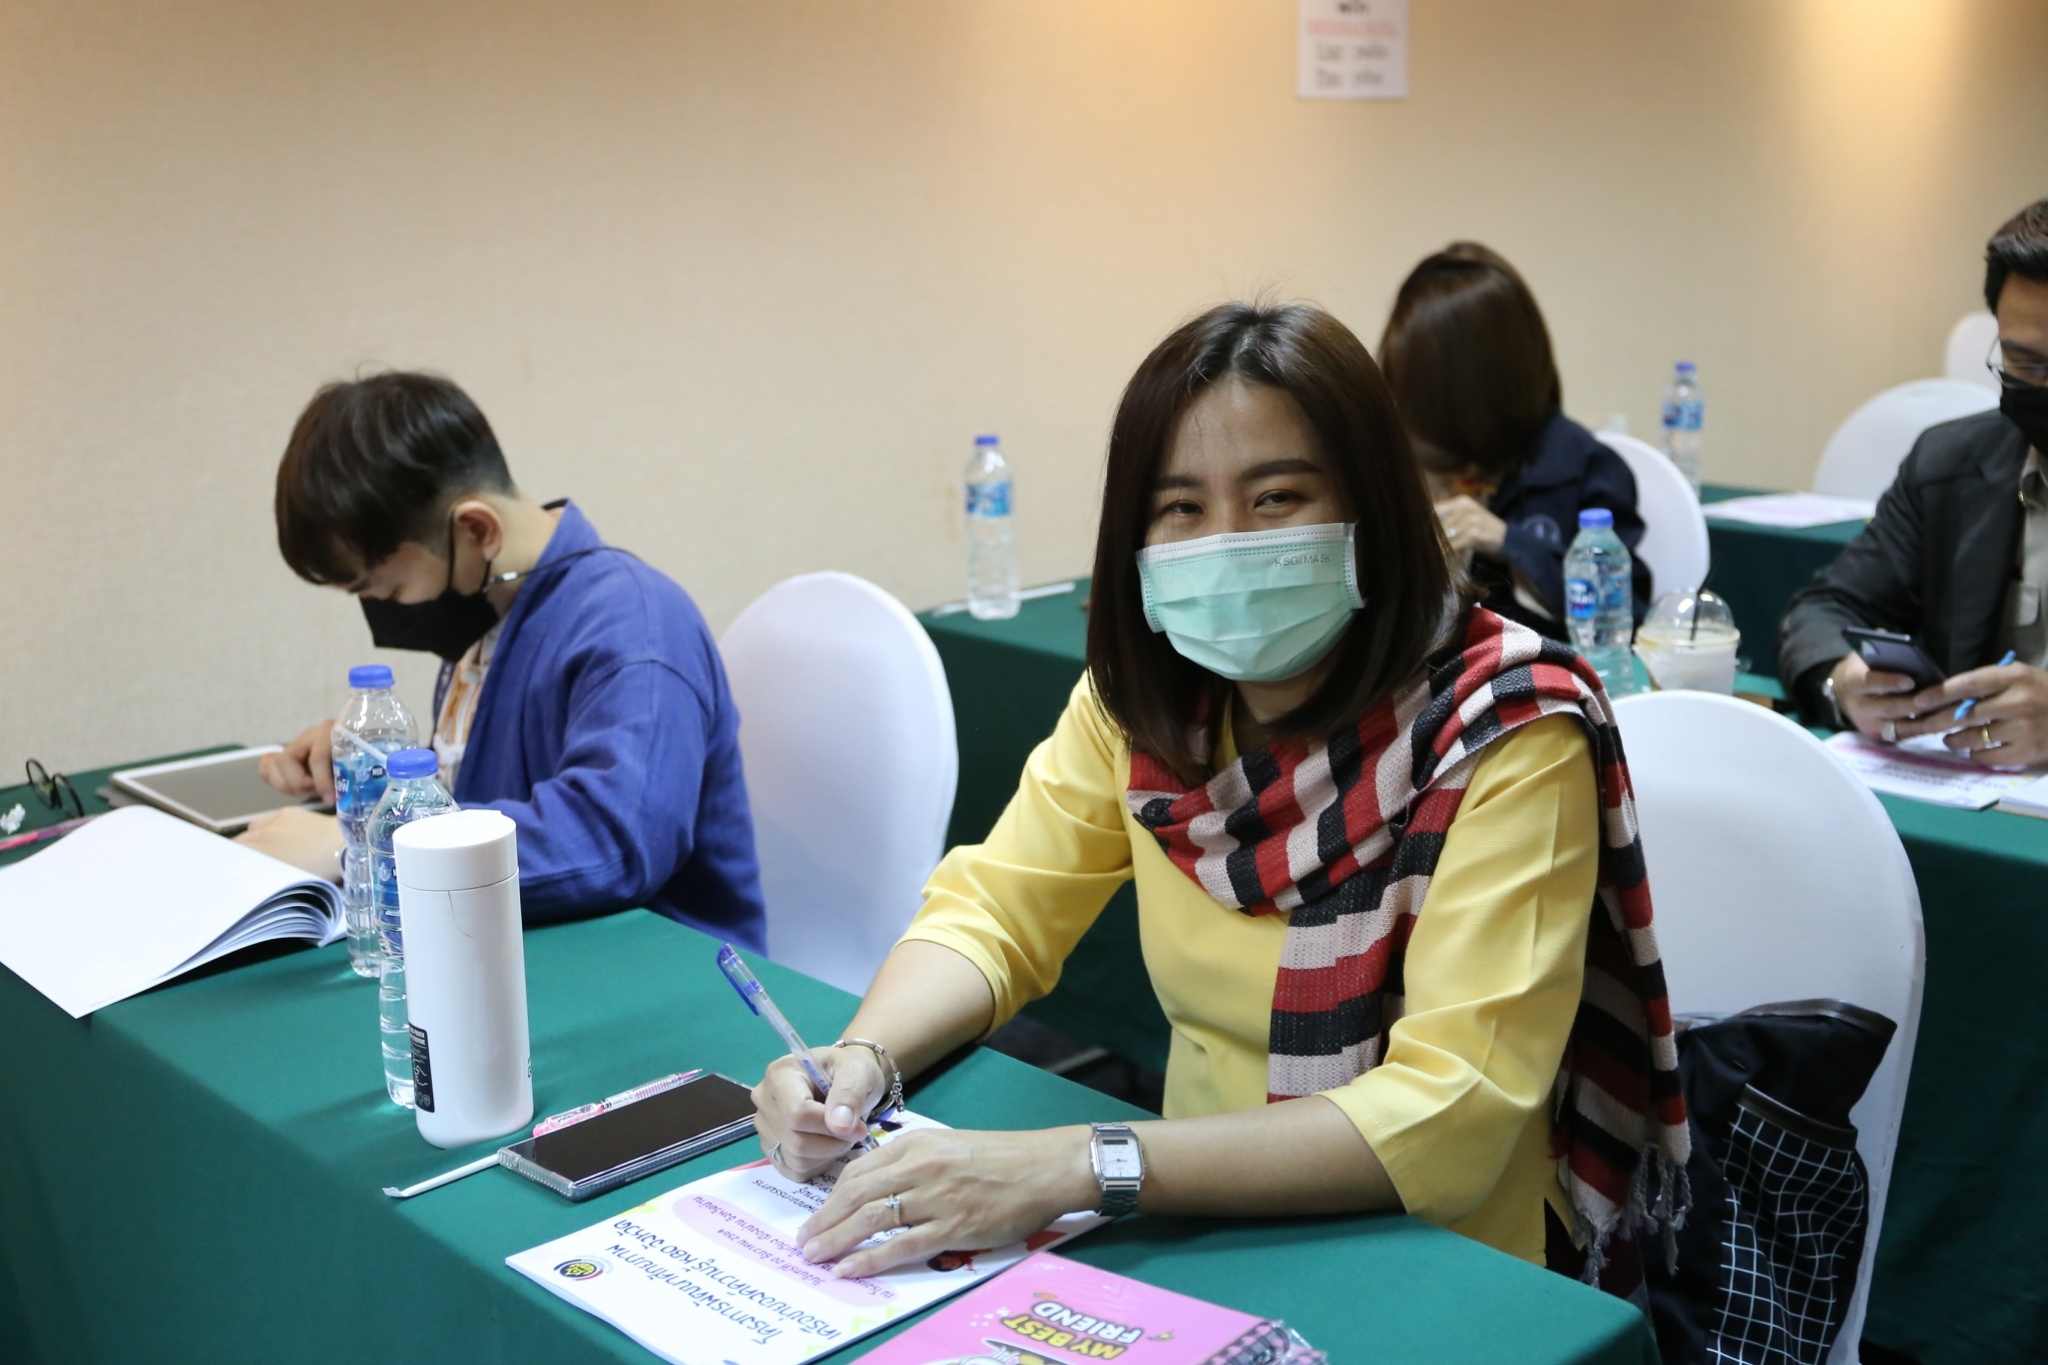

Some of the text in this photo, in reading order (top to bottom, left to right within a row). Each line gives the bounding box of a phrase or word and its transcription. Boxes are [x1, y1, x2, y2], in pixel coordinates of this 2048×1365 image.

[606, 1244, 782, 1345] โครงการพัฒนาศักยภาพ
[614, 1219, 842, 1340] เครือข่ายองค์ความรู้ KBO จังหวัด
[1001, 1315, 1127, 1360] MY BEST
[1032, 1301, 1143, 1344] FRIEND
